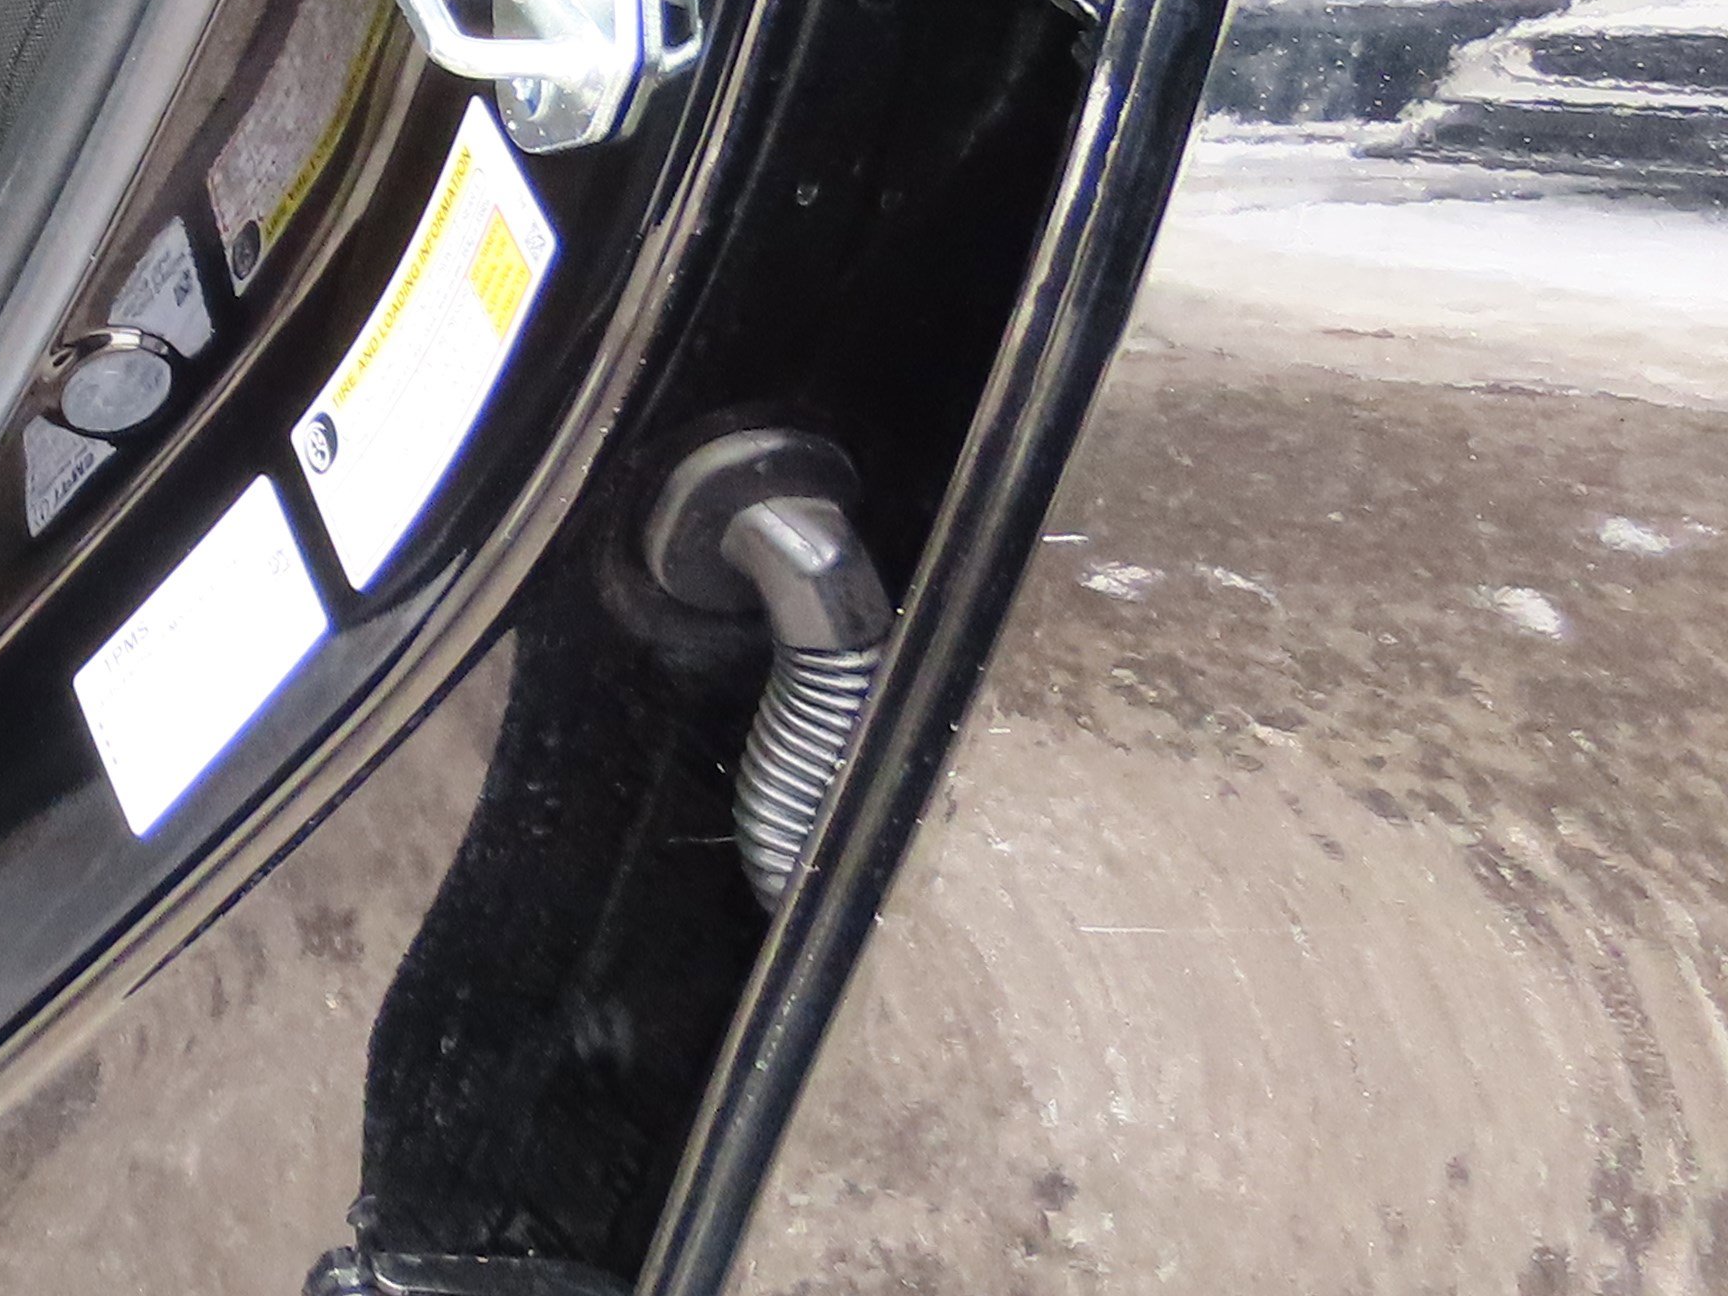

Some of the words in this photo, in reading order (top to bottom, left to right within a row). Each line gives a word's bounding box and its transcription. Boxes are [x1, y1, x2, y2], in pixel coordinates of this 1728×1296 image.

[356, 335, 382, 370] AND
[378, 263, 420, 338] LOADING
[417, 146, 471, 264] INFORMATION
